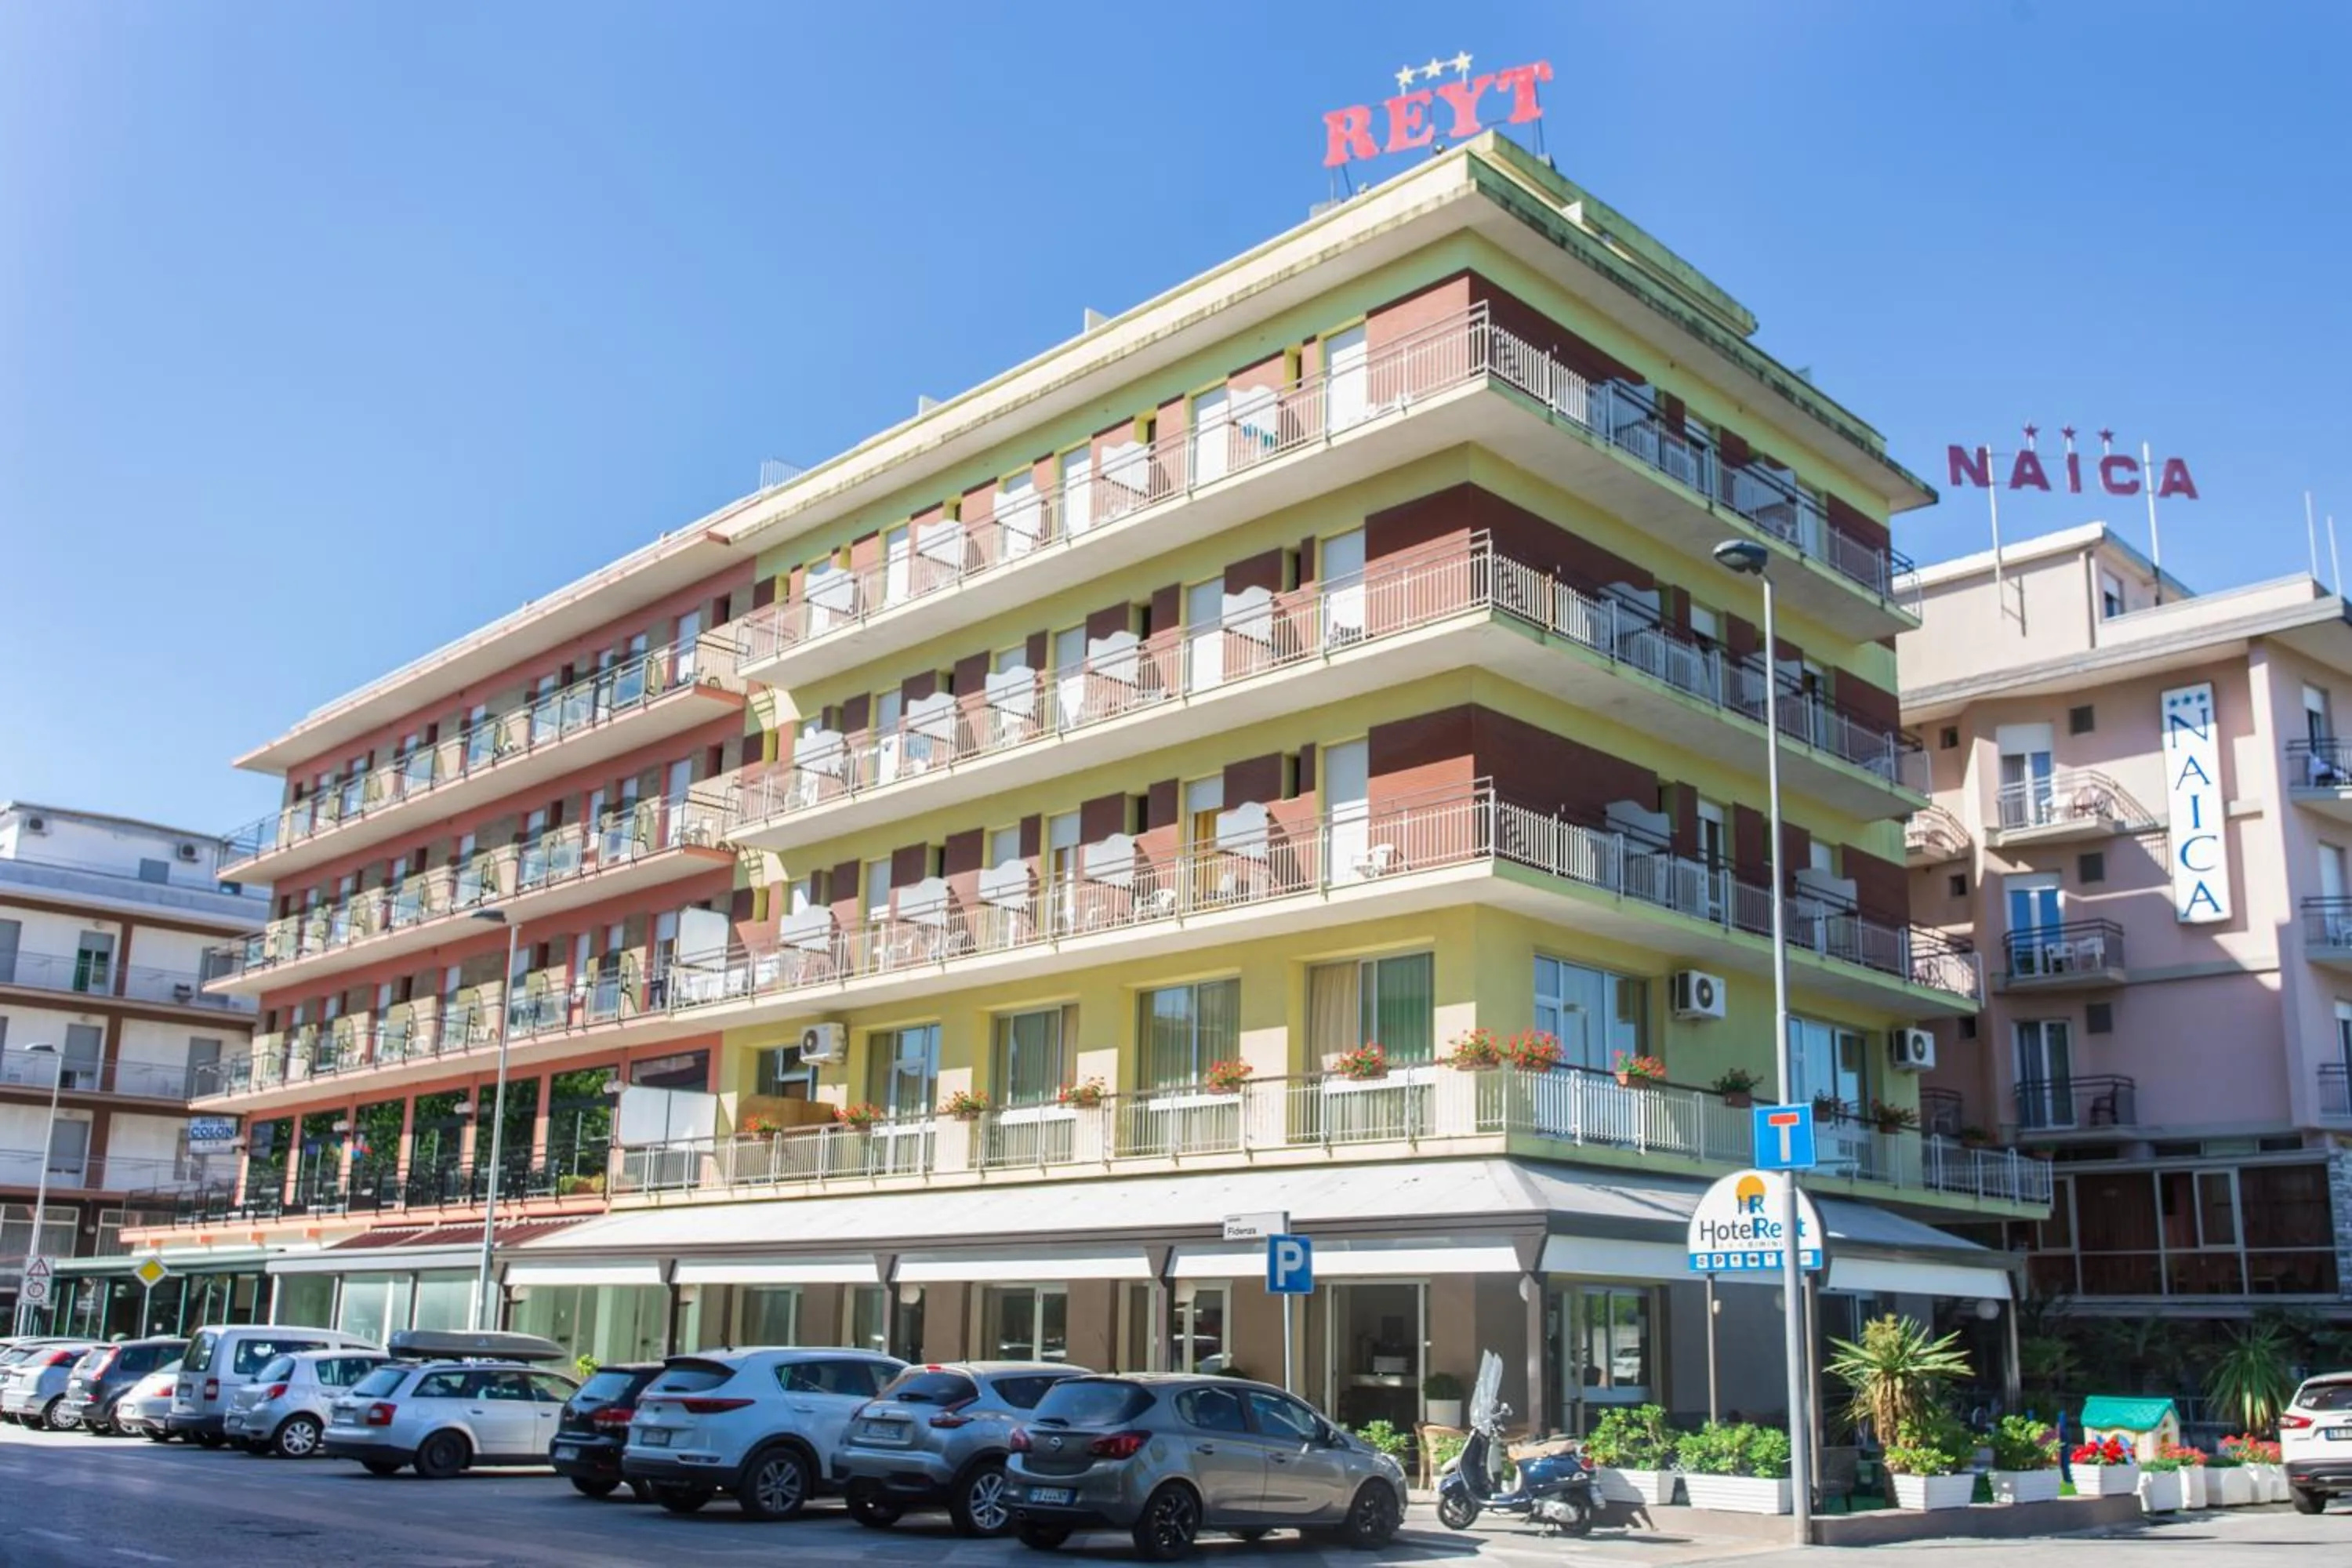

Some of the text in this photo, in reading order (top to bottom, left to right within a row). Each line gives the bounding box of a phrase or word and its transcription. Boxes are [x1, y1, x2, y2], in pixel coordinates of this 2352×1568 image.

[1323, 57, 1553, 167] REYT
[1947, 445, 2199, 499] NAICA
[2168, 707, 2222, 917] NAICA
[1276, 1241, 1303, 1287] P
